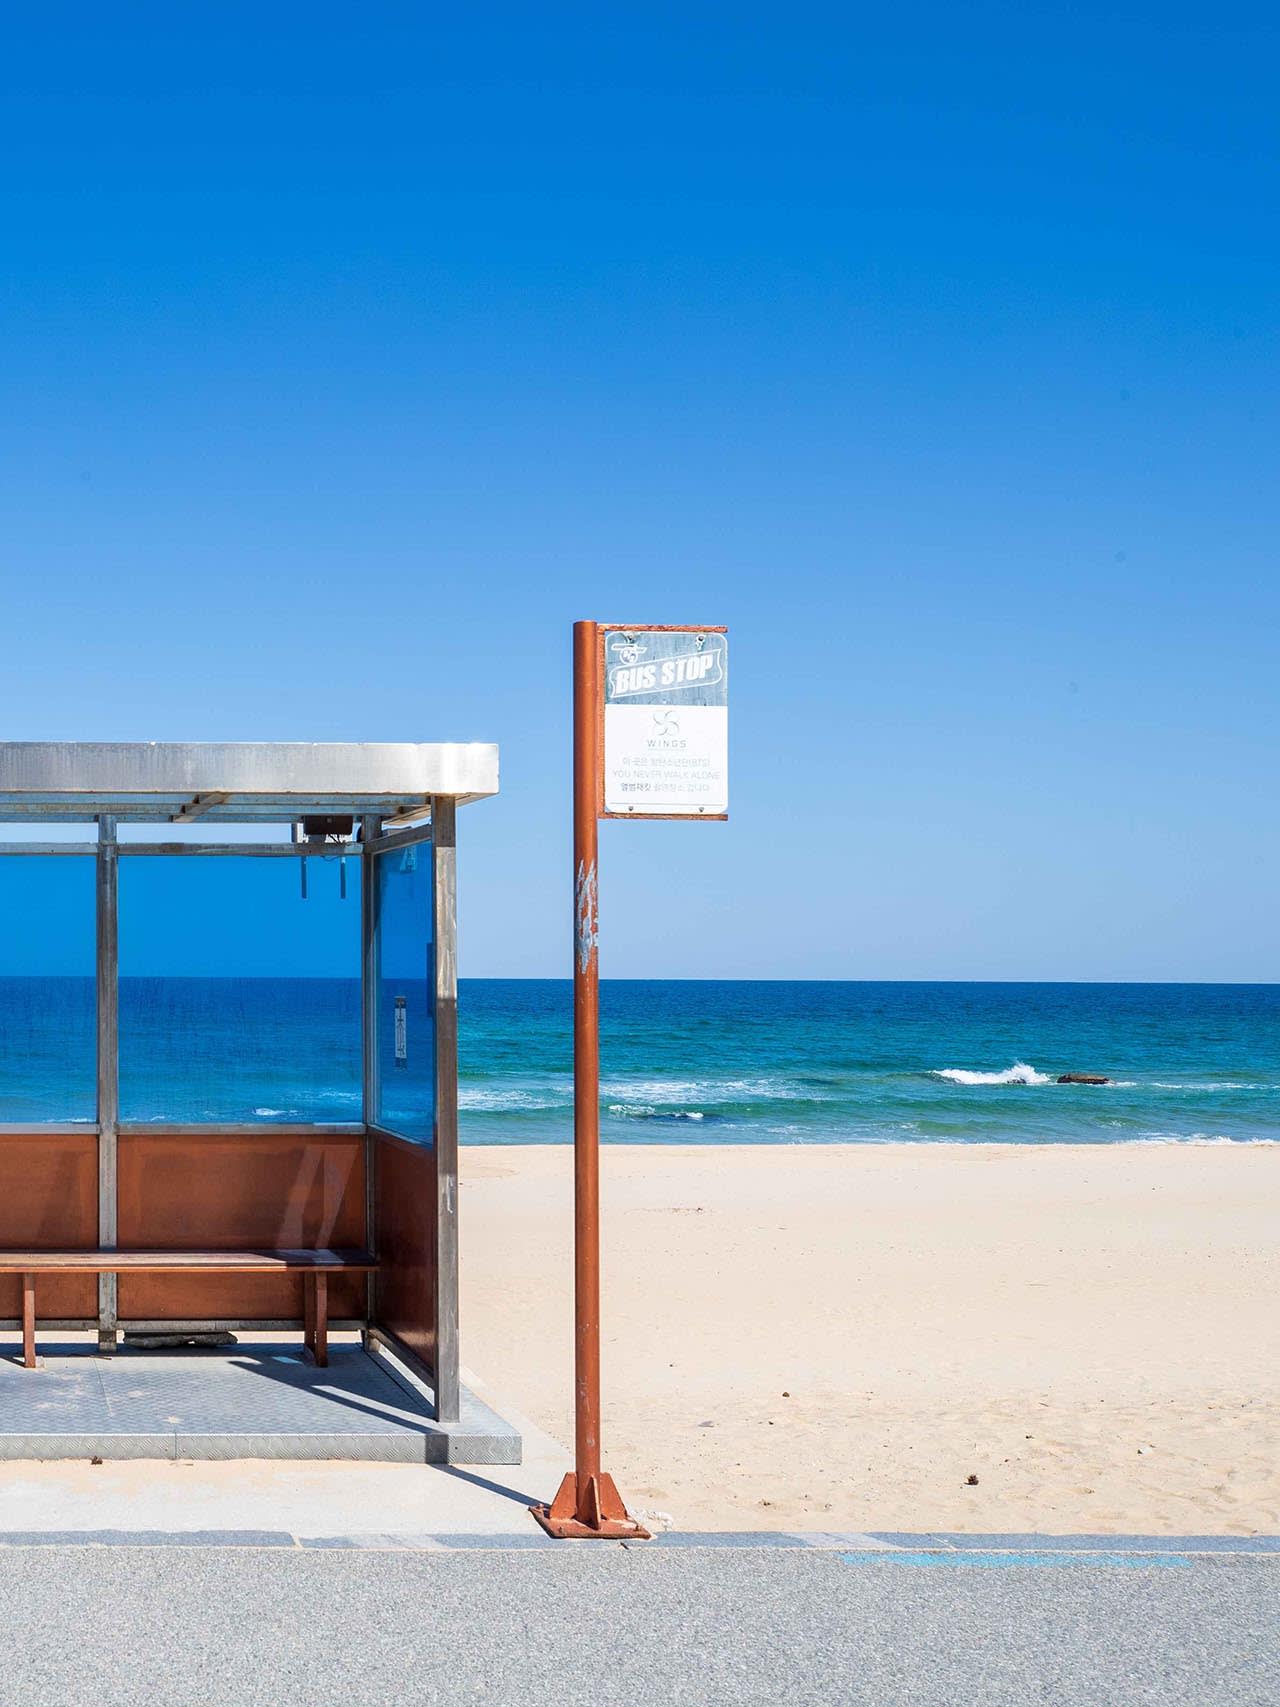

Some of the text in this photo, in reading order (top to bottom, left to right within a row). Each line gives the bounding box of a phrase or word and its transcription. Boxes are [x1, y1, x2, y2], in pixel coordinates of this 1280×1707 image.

[615, 654, 714, 694] BUS STOP
[647, 739, 687, 748] WINGS
[613, 769, 631, 778] YOU
